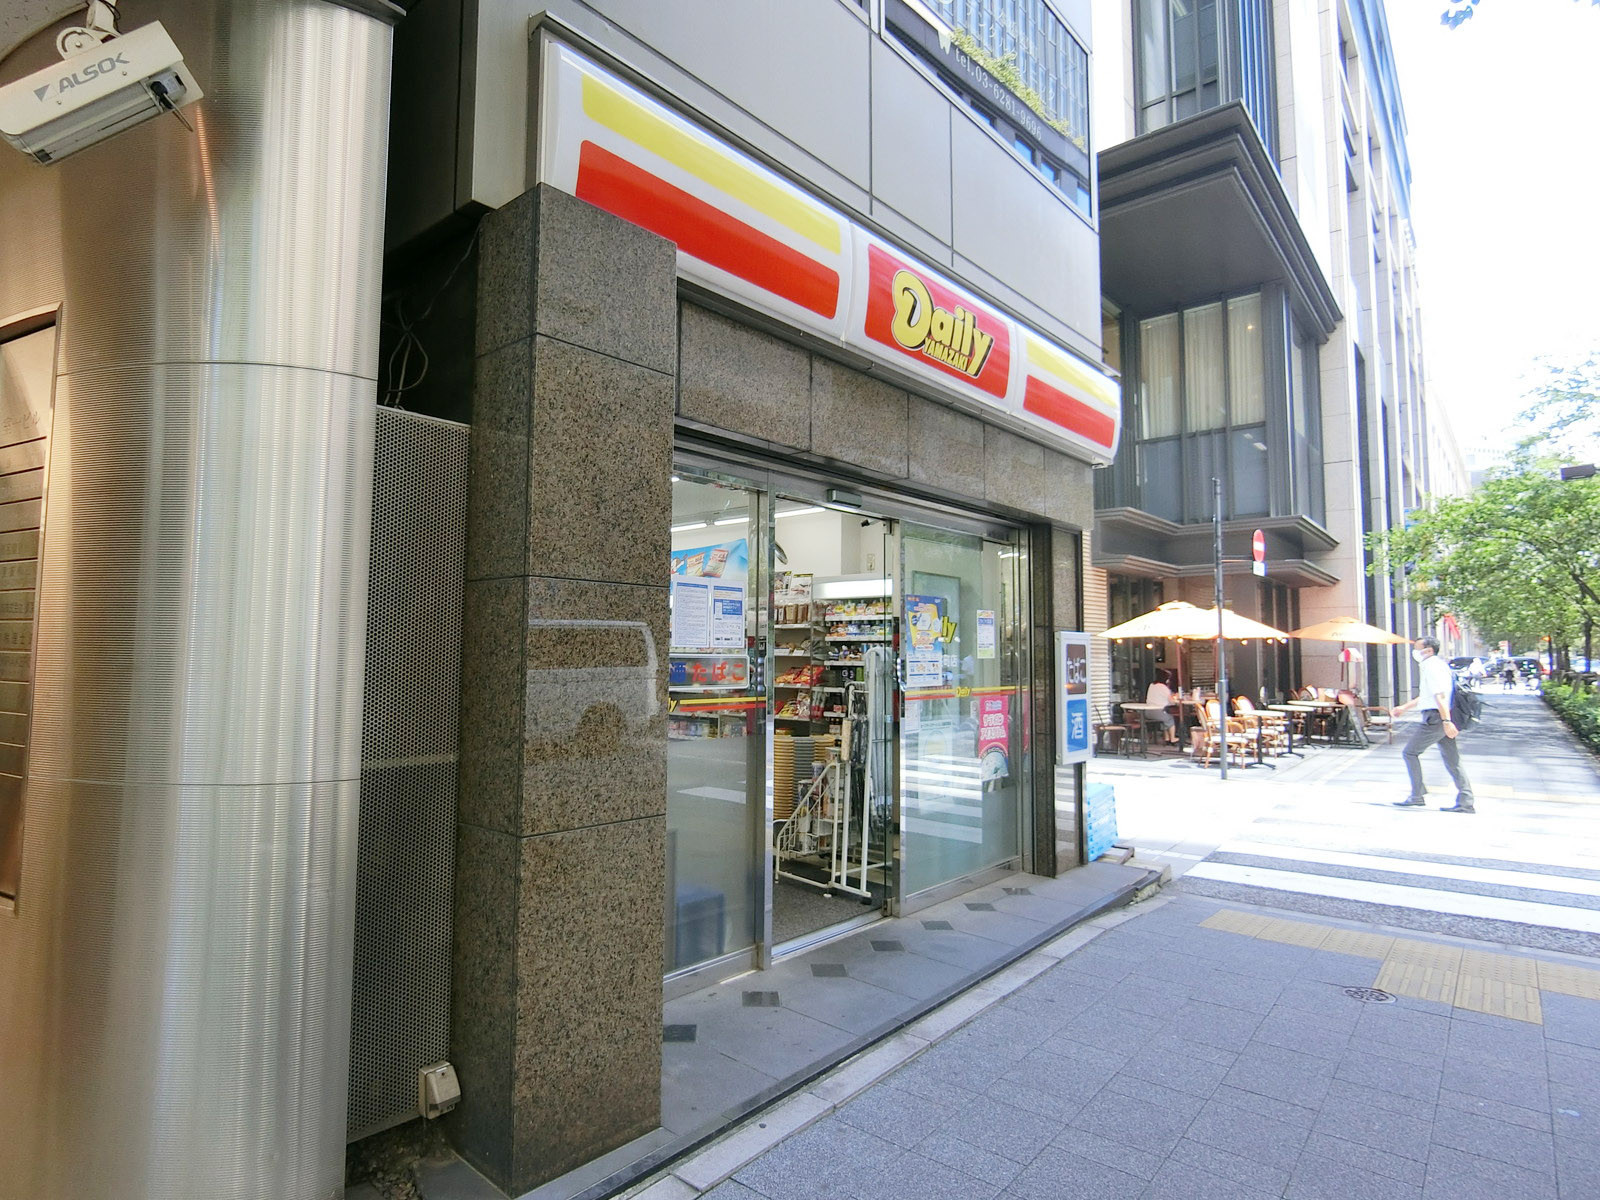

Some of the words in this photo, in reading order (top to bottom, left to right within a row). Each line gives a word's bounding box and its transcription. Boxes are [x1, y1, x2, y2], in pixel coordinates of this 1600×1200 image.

[58, 51, 130, 94] ALSOK
[892, 270, 994, 377] Daily
[924, 337, 969, 373] YAMAZAKI
[691, 660, 745, 683] たばこ
[1066, 657, 1087, 684] たばこ
[1071, 711, 1084, 740] 酒
